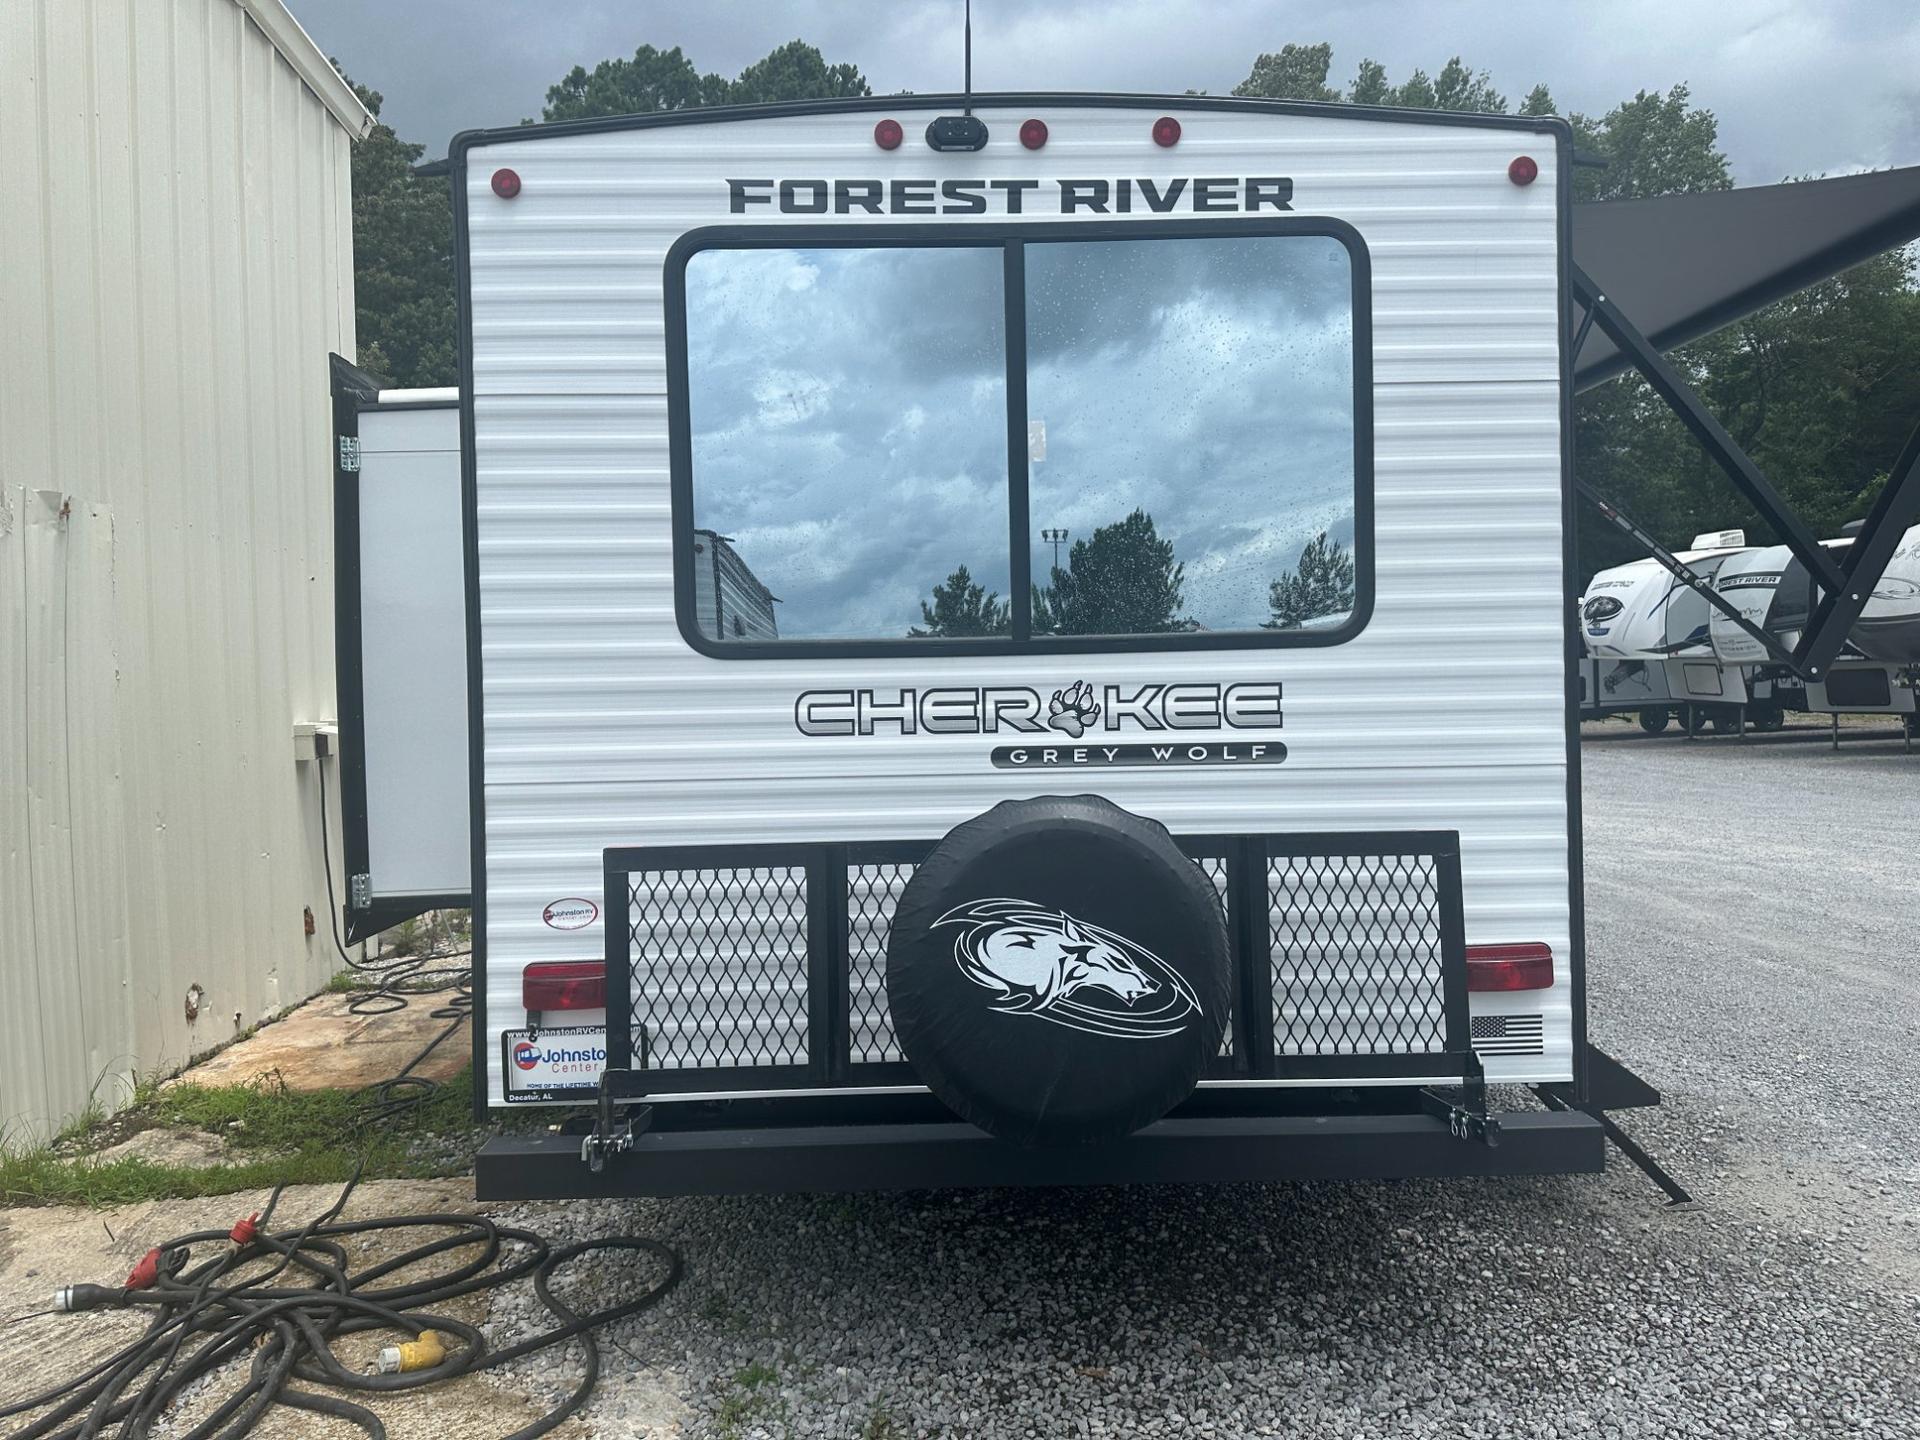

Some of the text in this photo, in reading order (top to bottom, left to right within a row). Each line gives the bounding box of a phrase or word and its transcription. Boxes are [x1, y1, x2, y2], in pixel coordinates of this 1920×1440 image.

[725, 177, 1295, 214] FOREST RIVER
[1744, 576, 1777, 584] RIVER
[1009, 744, 1267, 764] GREY WOLF
[542, 1047, 606, 1062] Johnsto
